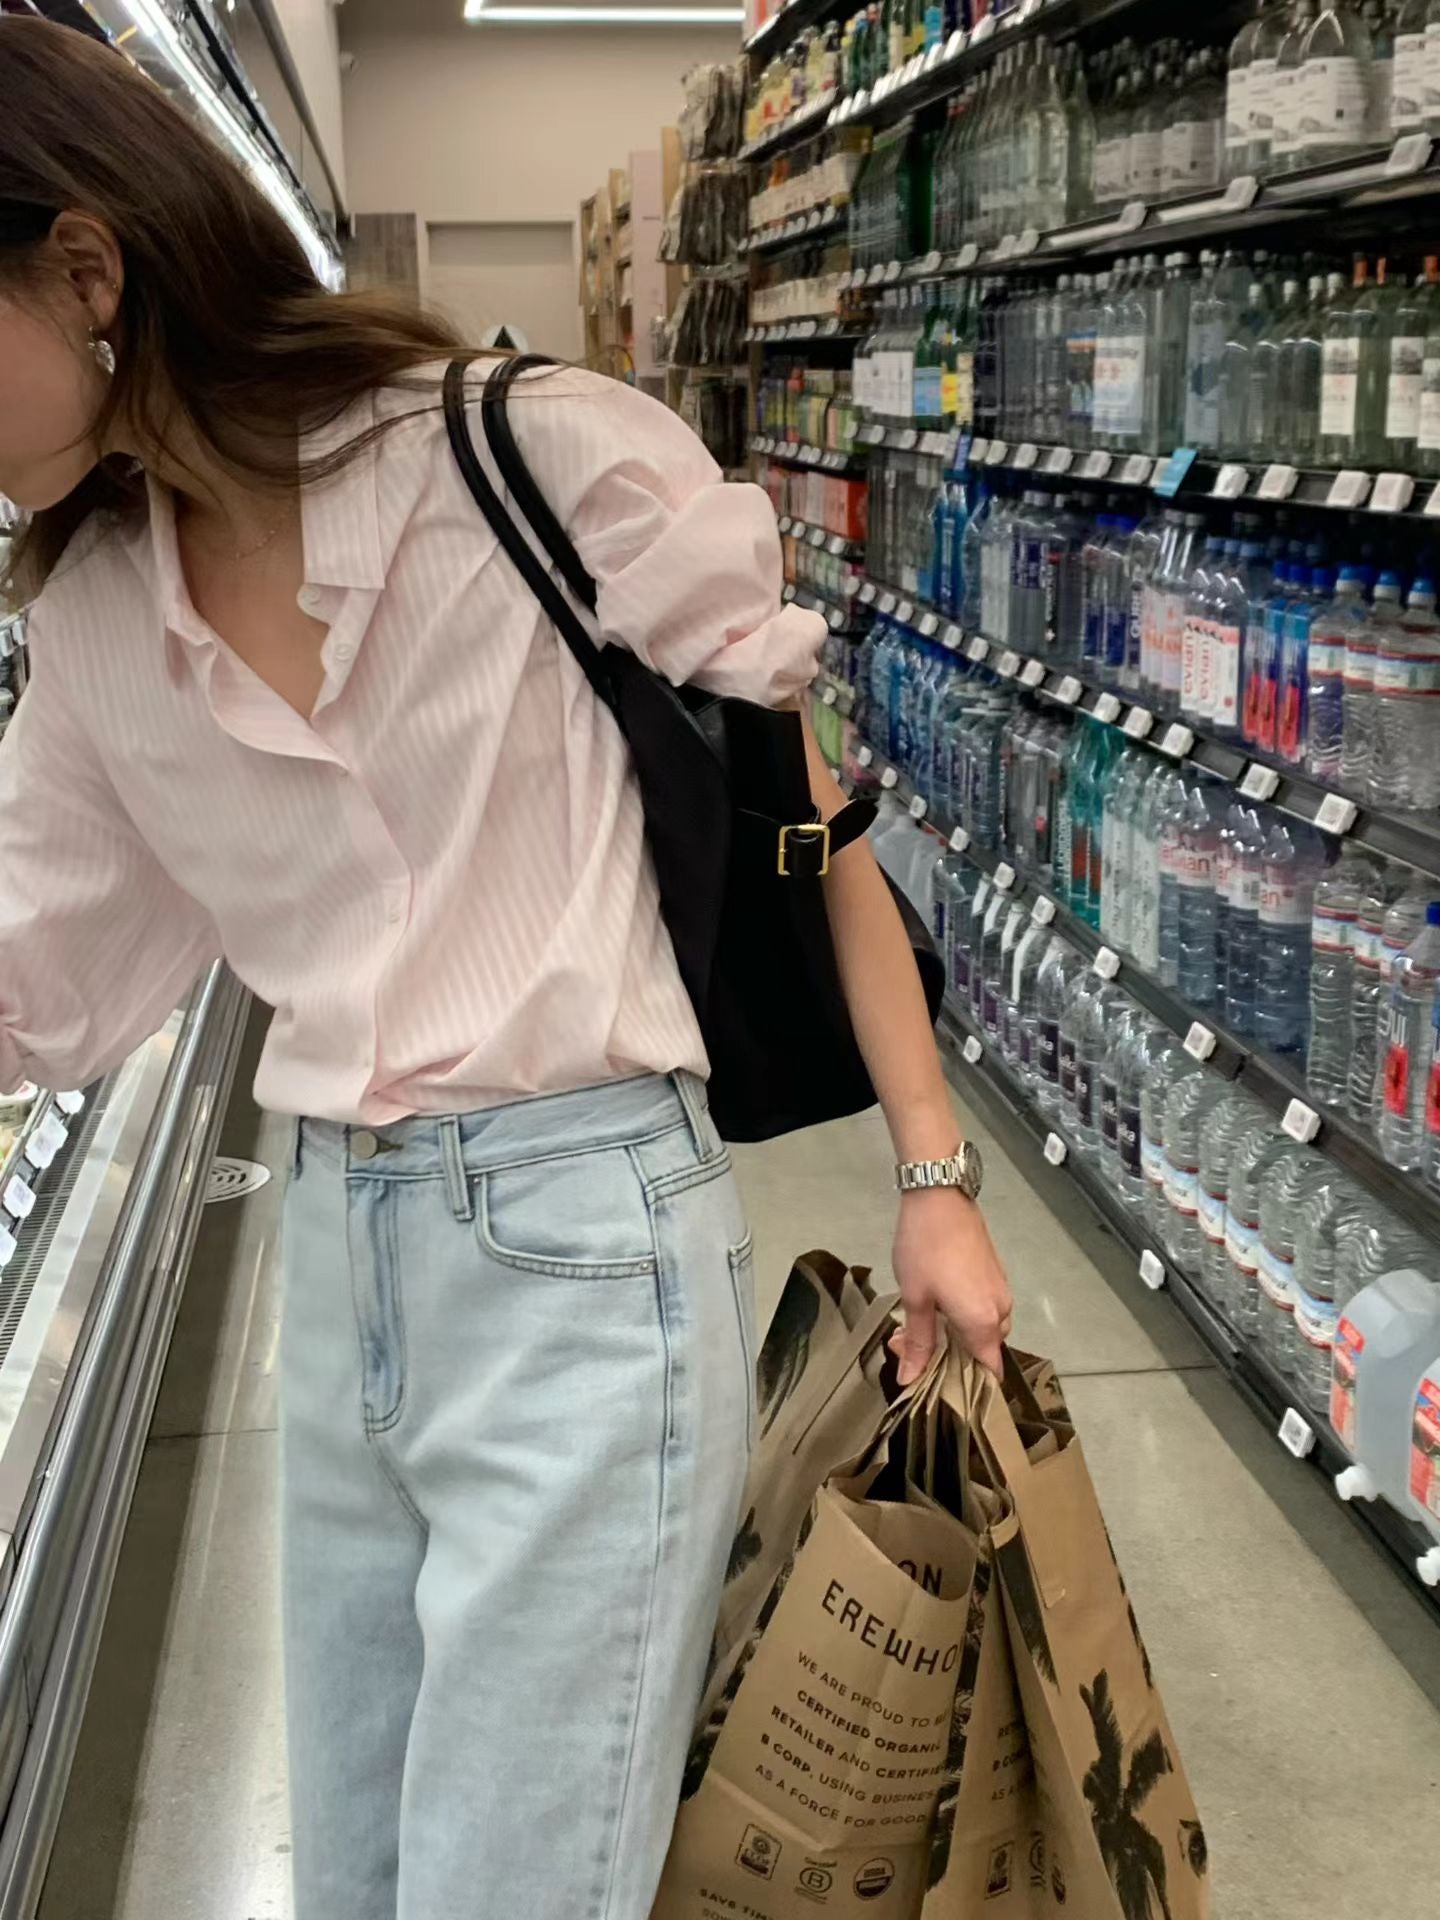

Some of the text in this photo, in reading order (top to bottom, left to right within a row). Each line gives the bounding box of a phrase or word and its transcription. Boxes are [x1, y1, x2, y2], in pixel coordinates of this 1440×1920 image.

[797, 1689, 871, 1739] CERTIFIED
[798, 1650, 818, 1674] WE
[819, 1672, 848, 1696] ARE
[850, 1691, 904, 1724] PROUD
[910, 1716, 930, 1728] TO
[771, 1705, 835, 1756] RETAILER
[838, 1751, 871, 1772] AND
[755, 1764, 773, 1781] AS
[776, 1778, 786, 1791] A
[789, 1786, 841, 1821] FORCE
[843, 1815, 877, 1828] FOR
[819, 1772, 867, 1802] USING
